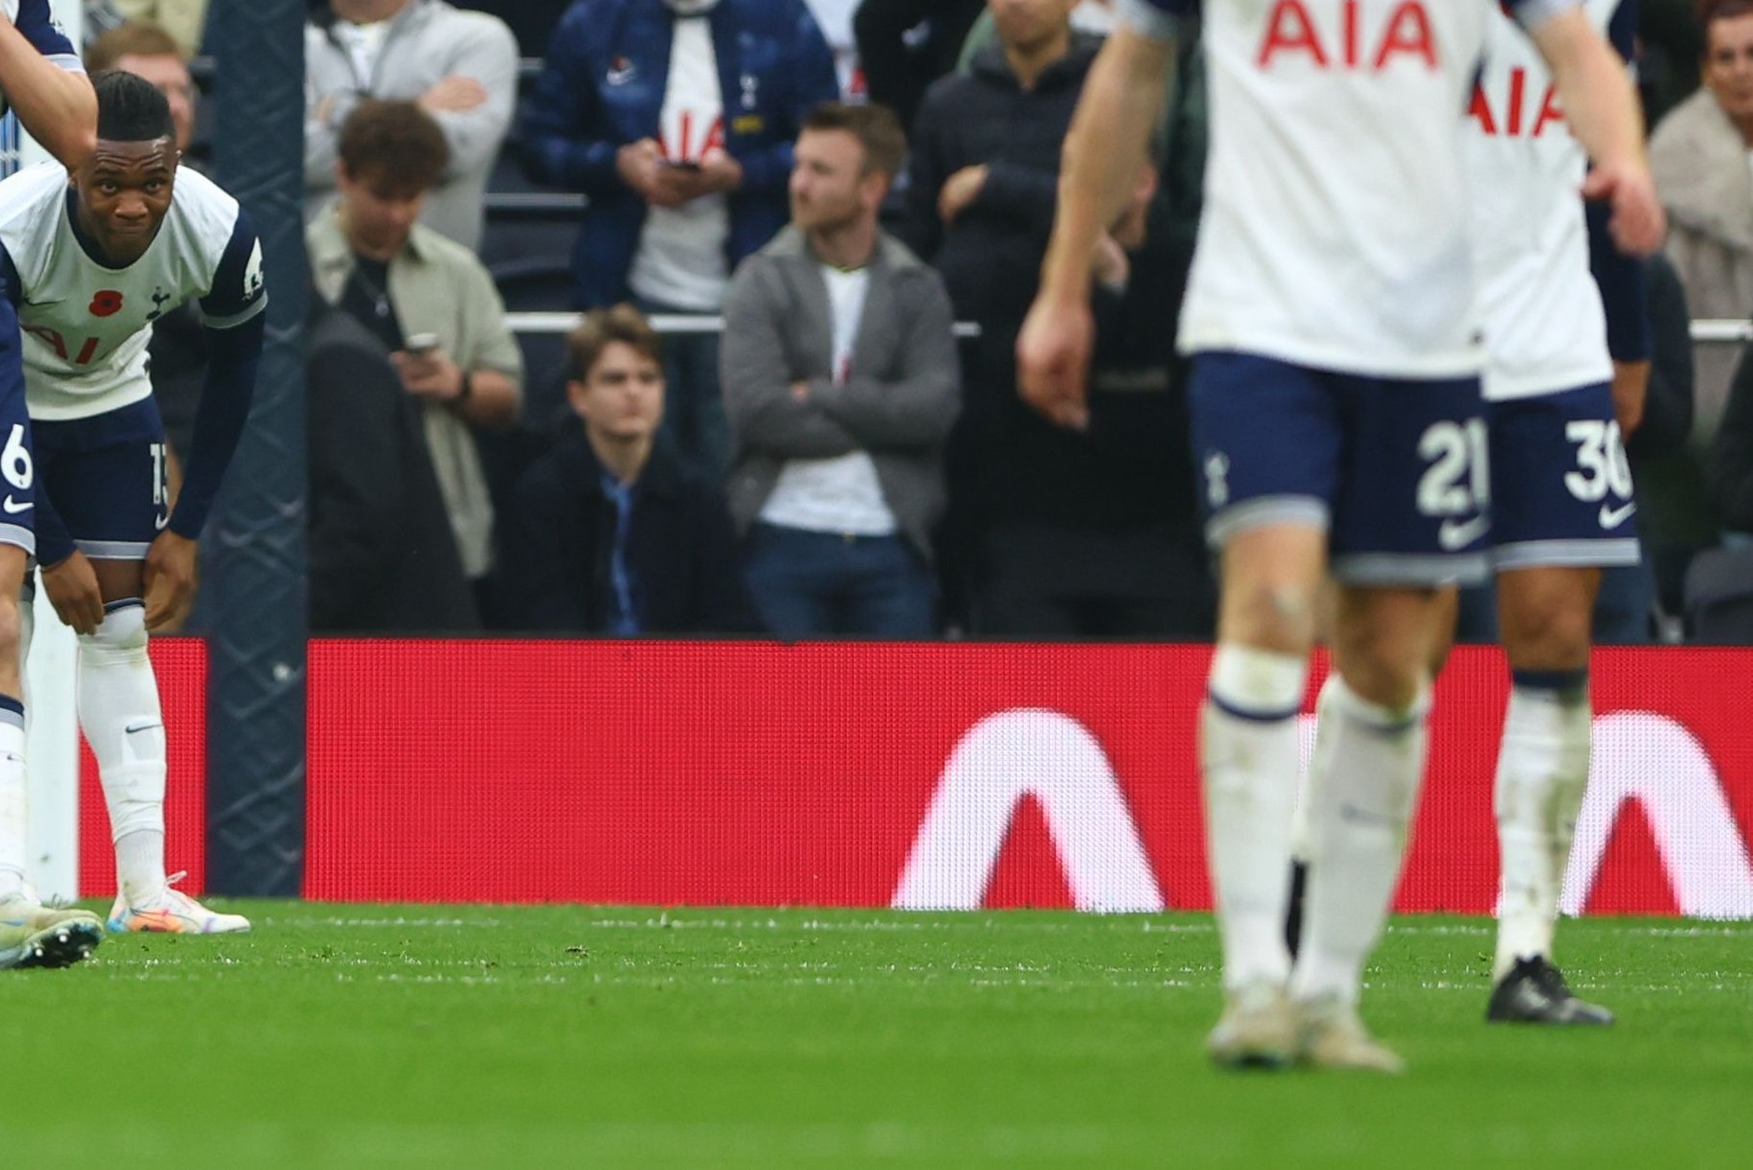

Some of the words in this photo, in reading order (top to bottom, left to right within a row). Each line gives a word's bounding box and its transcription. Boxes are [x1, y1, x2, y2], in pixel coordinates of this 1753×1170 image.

[0, 423, 34, 490] 6
[150, 443, 168, 505] 1
[1416, 416, 1491, 516] 21
[1564, 419, 1634, 501] 30
